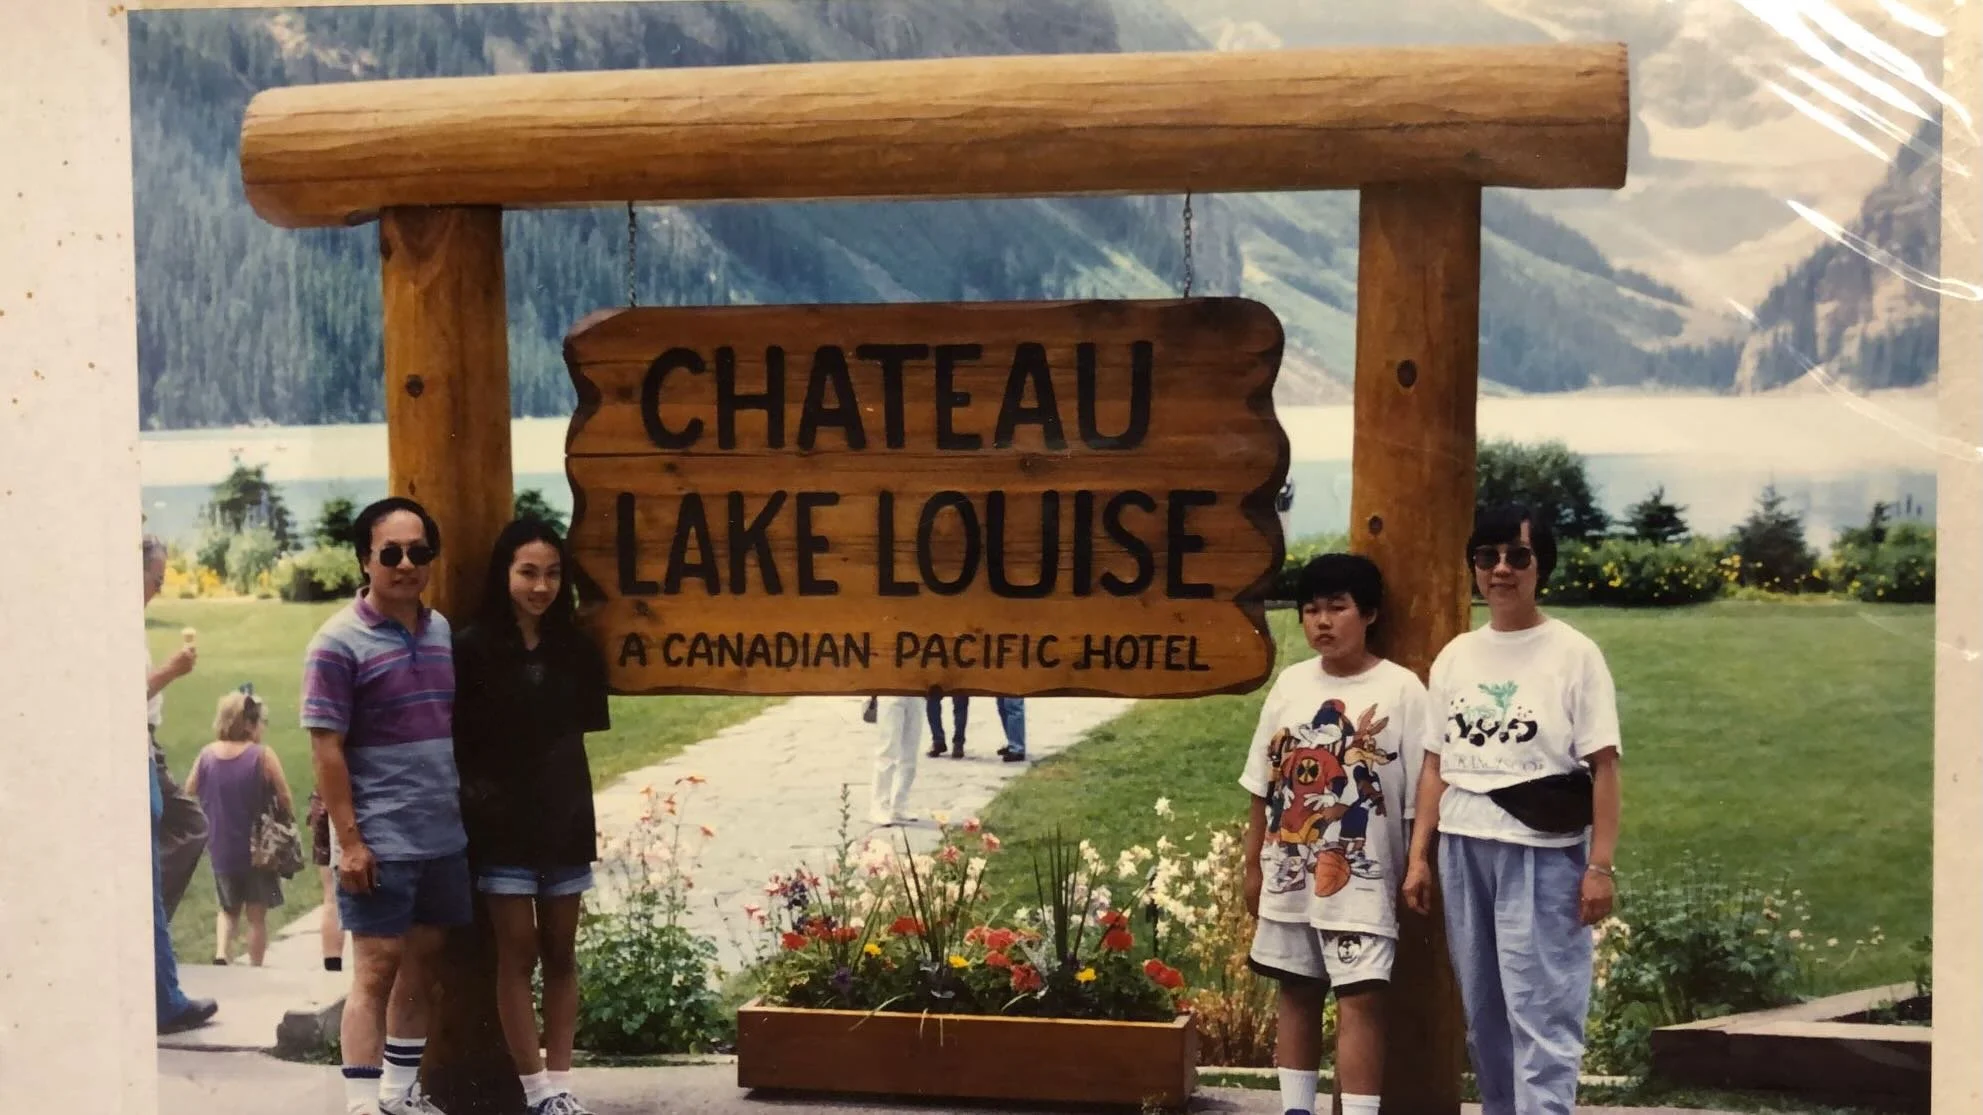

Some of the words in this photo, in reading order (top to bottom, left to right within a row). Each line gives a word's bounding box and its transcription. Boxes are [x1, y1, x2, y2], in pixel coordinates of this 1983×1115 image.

[641, 341, 1154, 451] CHATEAU
[616, 490, 840, 596] LAKE
[877, 489, 1217, 598] LOUISE
[618, 633, 648, 668] A
[662, 631, 871, 669] CANADIAN
[895, 631, 1060, 668] PACIFIC
[1073, 633, 1211, 671] HOTEL
